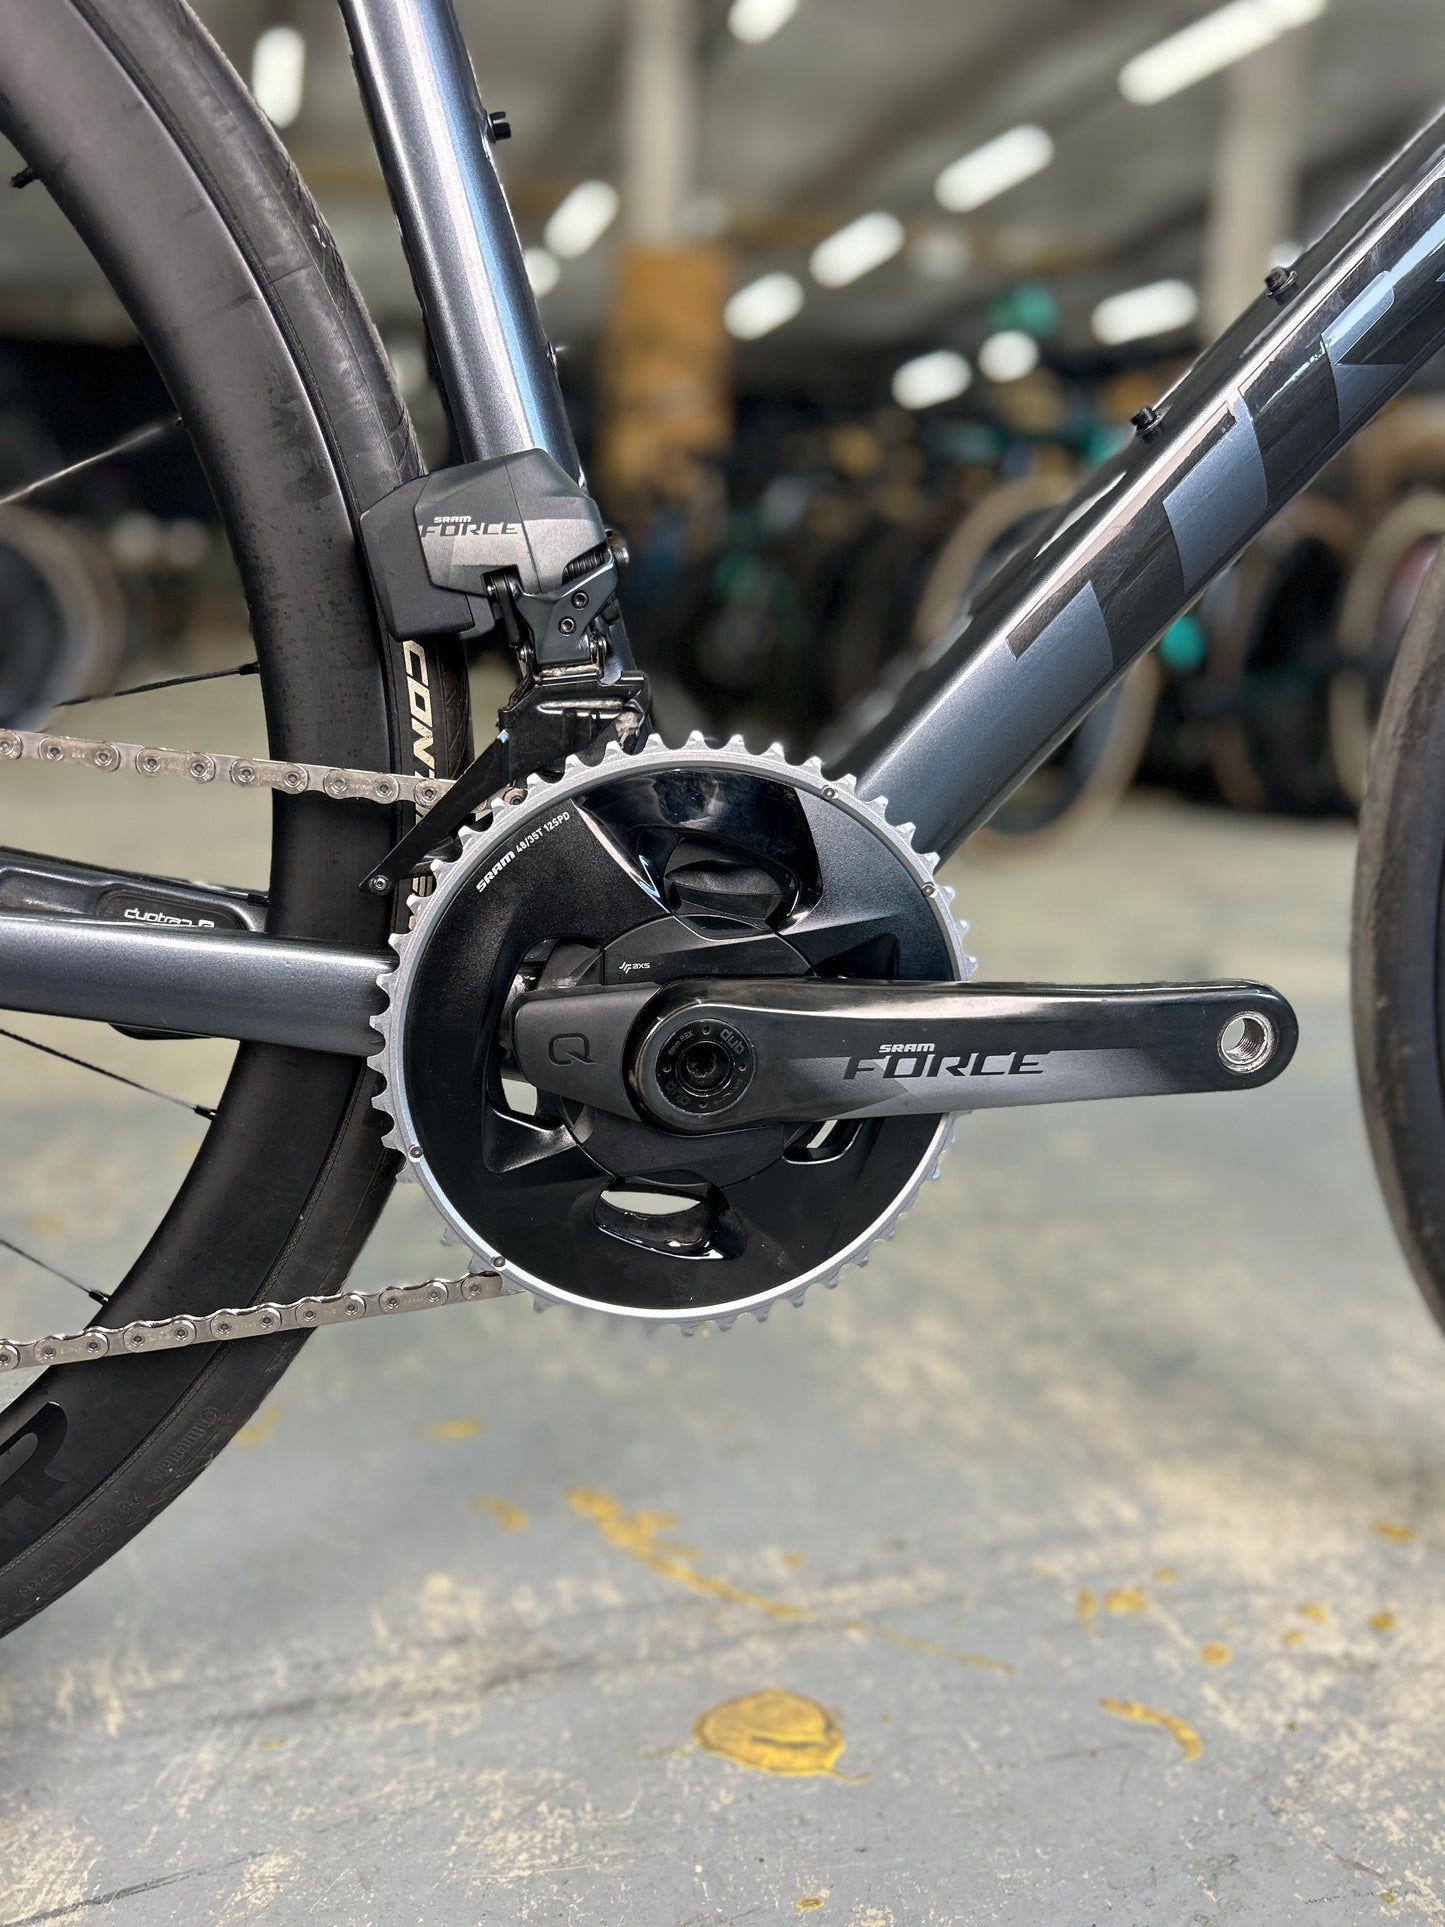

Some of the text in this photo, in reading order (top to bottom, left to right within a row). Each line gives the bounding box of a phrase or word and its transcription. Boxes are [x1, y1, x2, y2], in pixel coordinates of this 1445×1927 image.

[420, 521, 519, 538] FORCE
[433, 515, 472, 524] SRAM
[476, 811, 570, 893] SRAM 48/35T 12SPD
[720, 1028, 746, 1056] dub
[878, 1042, 936, 1054] SRAM
[842, 1052, 1045, 1081] FORCE
